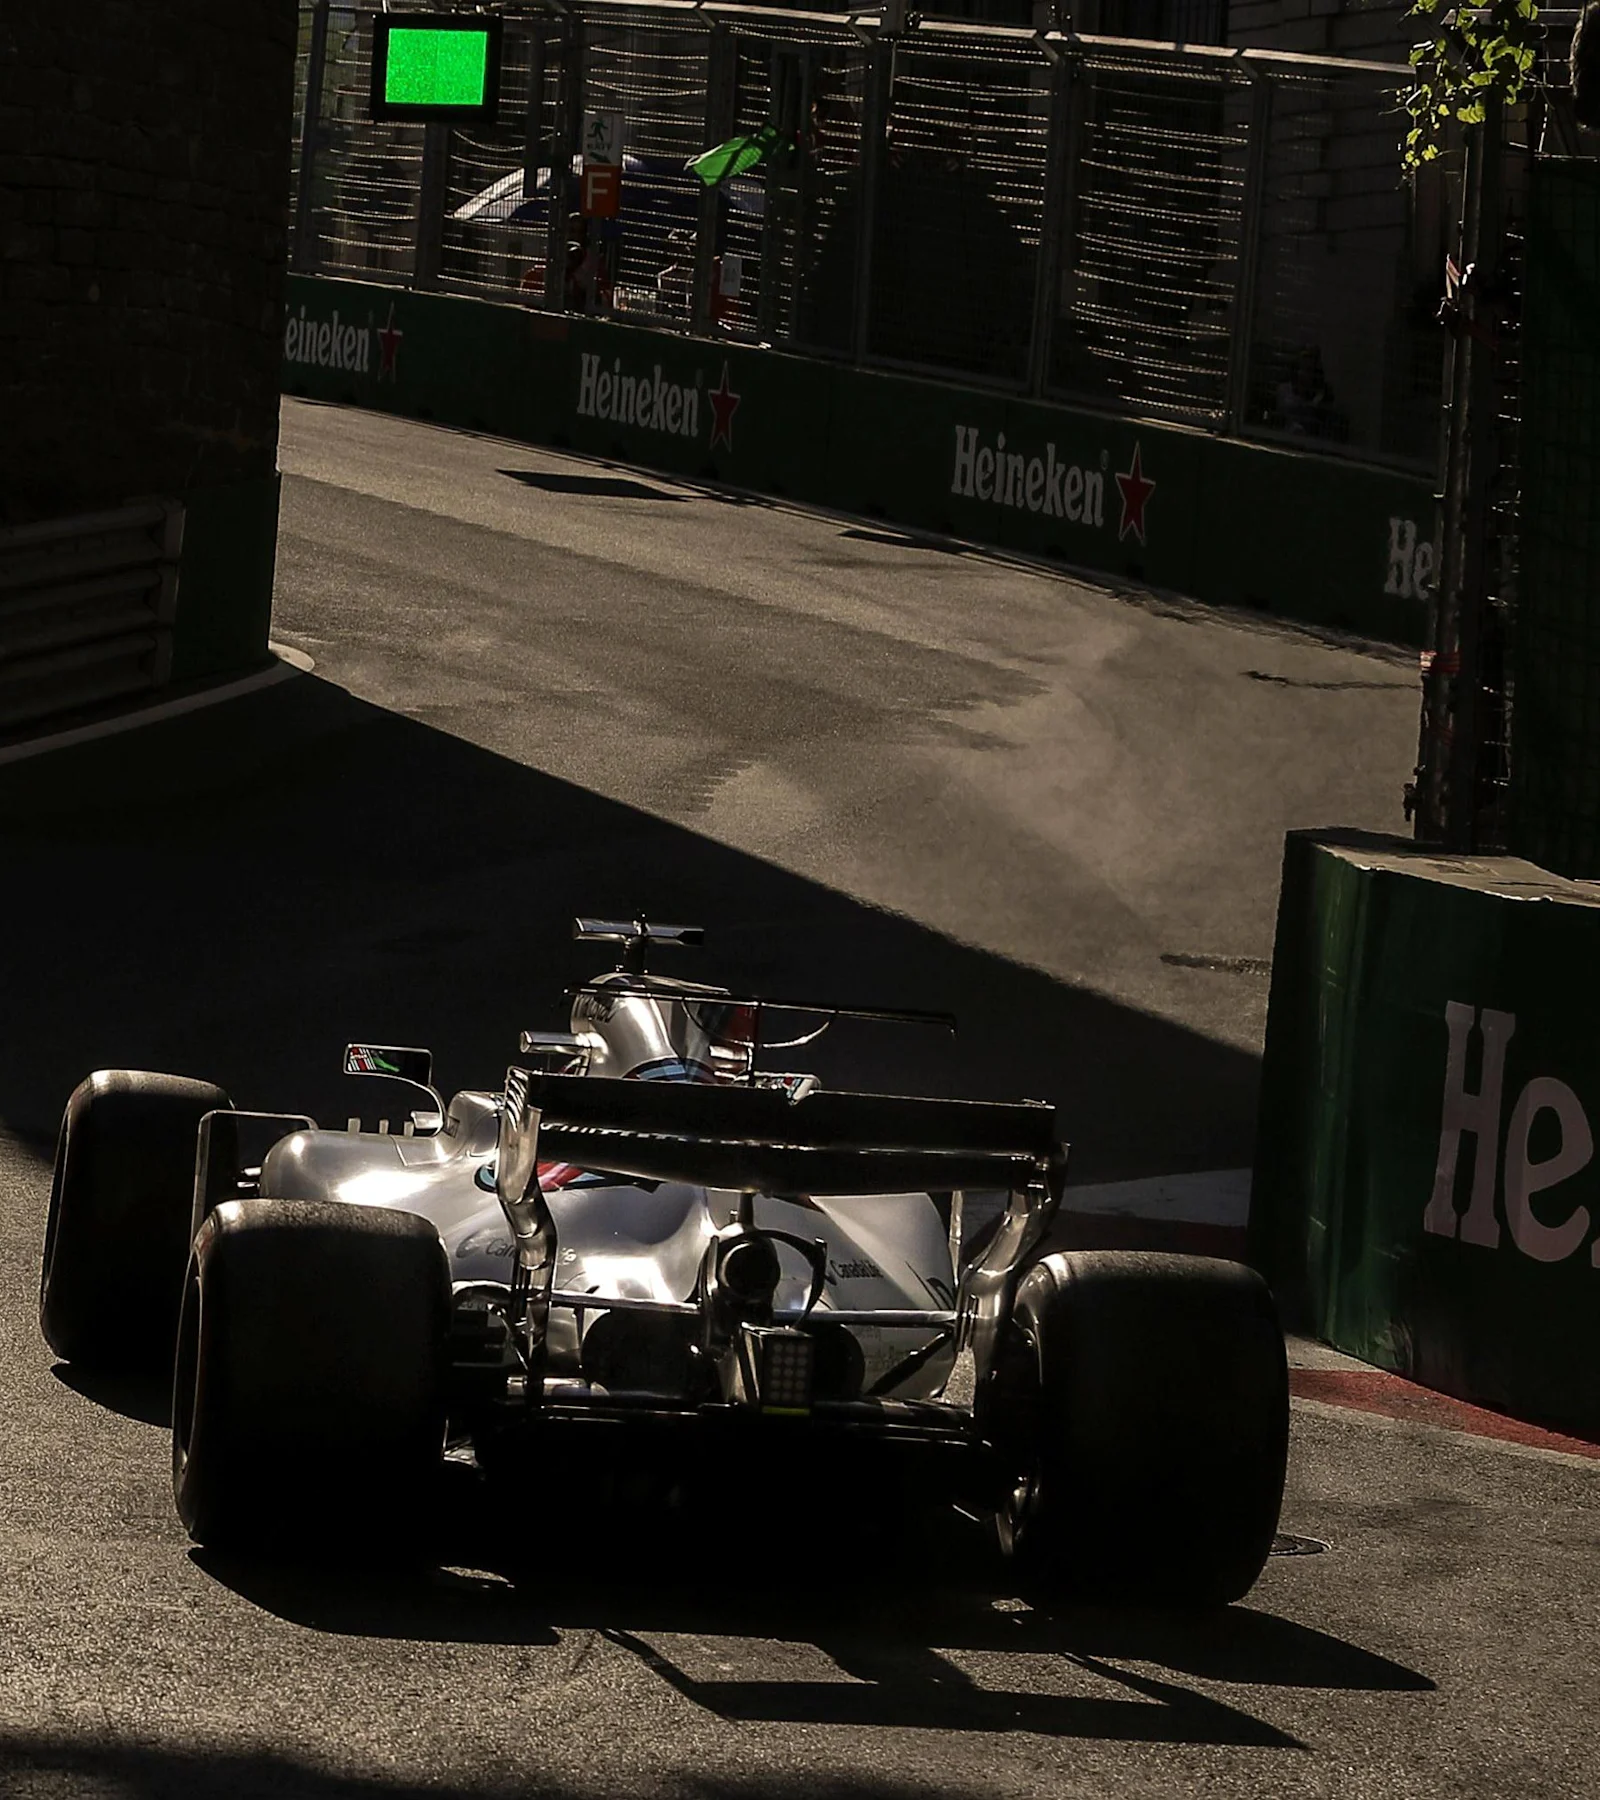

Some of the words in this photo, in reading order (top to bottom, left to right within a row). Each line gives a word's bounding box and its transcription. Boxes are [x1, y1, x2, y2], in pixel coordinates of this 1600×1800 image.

[586, 171, 612, 210] F
[283, 303, 371, 373] eineken
[576, 352, 699, 437] Heineken
[951, 424, 1104, 527] Heineken
[1423, 1000, 1600, 1269] He
